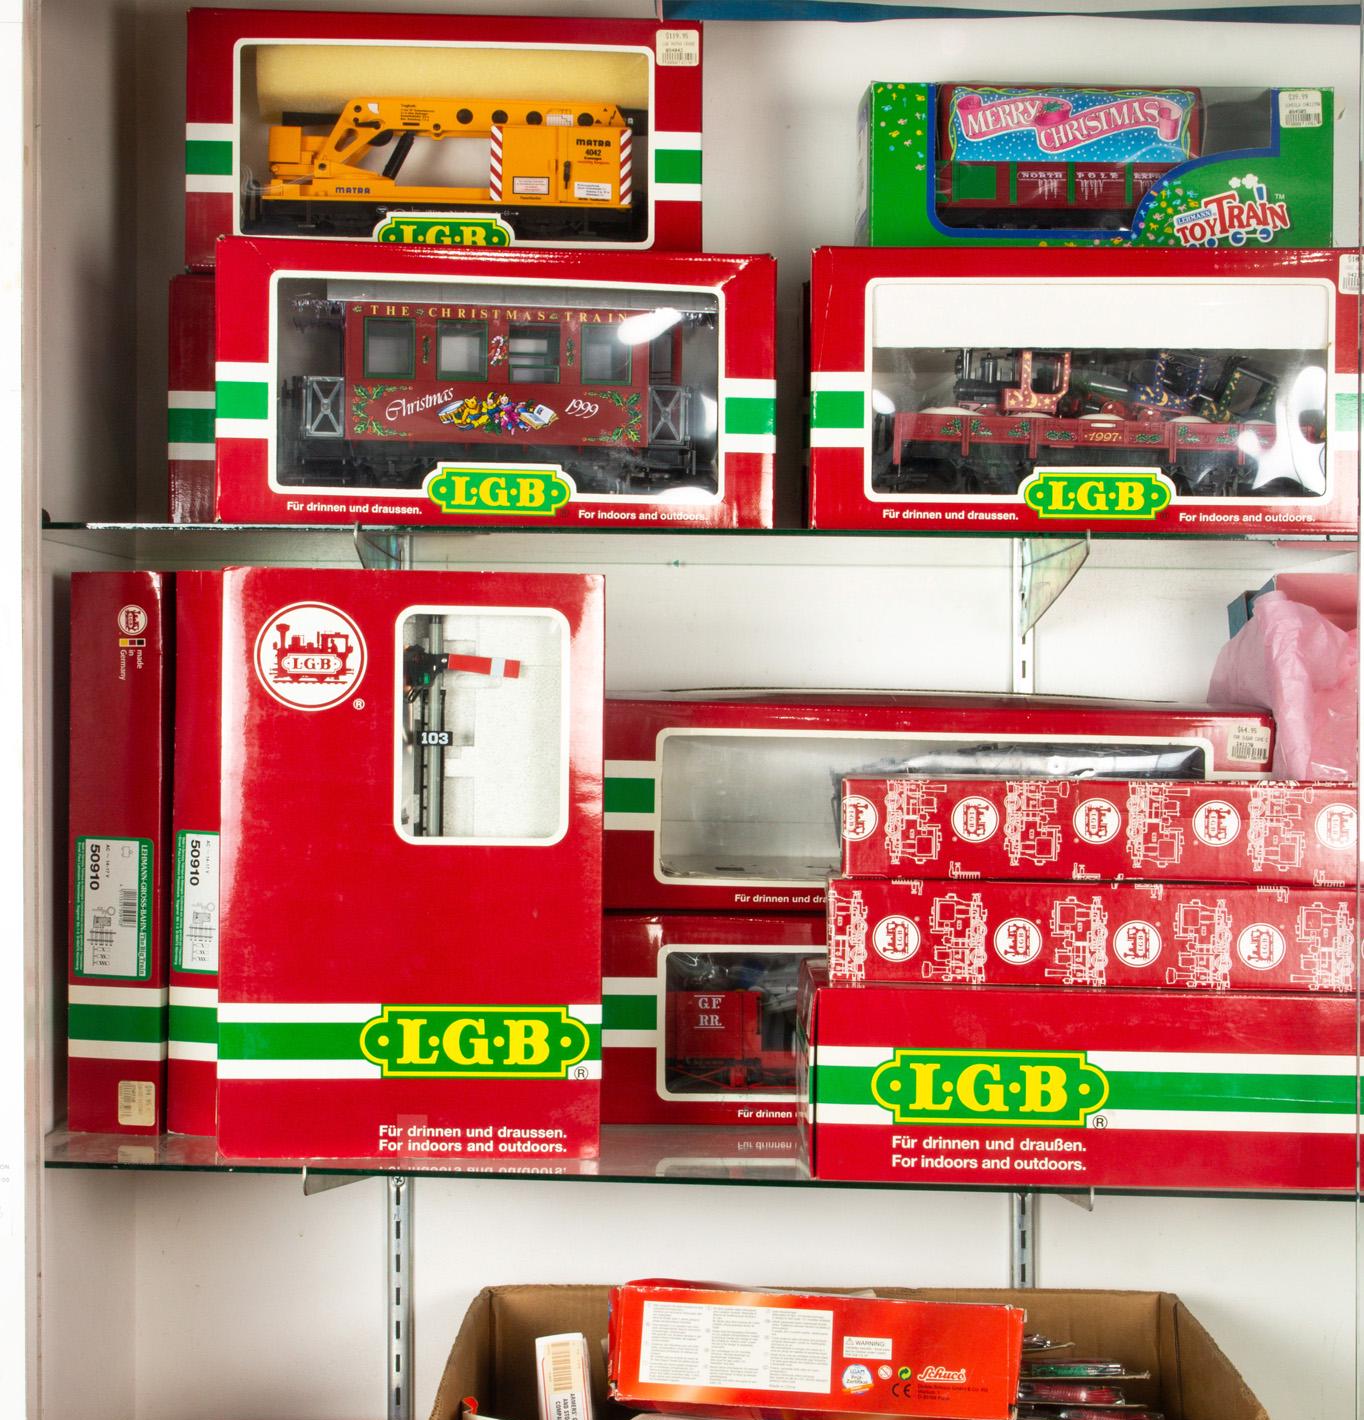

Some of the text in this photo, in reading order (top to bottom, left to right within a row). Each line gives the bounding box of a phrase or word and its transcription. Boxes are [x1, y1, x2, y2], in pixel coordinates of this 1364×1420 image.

[966, 100, 1041, 137] MERRY
[1040, 101, 1160, 148] CHRISTMAS
[1021, 171, 1063, 179] NORTH
[1176, 192, 1290, 244] TOY TRAIN
[370, 305, 628, 323] THE CHRISTMAS TRAIN
[386, 387, 454, 421] Christmas
[564, 399, 599, 419] 1999
[1088, 432, 1120, 442] 1997
[287, 501, 422, 514] Für drinnen und draussen.
[882, 508, 1018, 521] Für drinnen und draussen.
[578, 510, 708, 521] For indoors and outdoors.
[1179, 512, 1316, 523] For indoors and outdoors.
[420, 732, 449, 745] 103
[89, 843, 101, 890] 50910
[189, 839, 201, 886] 50910
[734, 893, 827, 903] Für drinnen und dra
[737, 1109, 753, 1118] Für
[755, 1109, 792, 1118] drinnen
[379, 1124, 568, 1139] Für drinnen und draussen.
[379, 1139, 568, 1153] For indoors and outdoors.
[891, 1134, 1087, 1152] Für drinnen und draußen.
[891, 1154, 1087, 1171] For indoors and outdoors.
